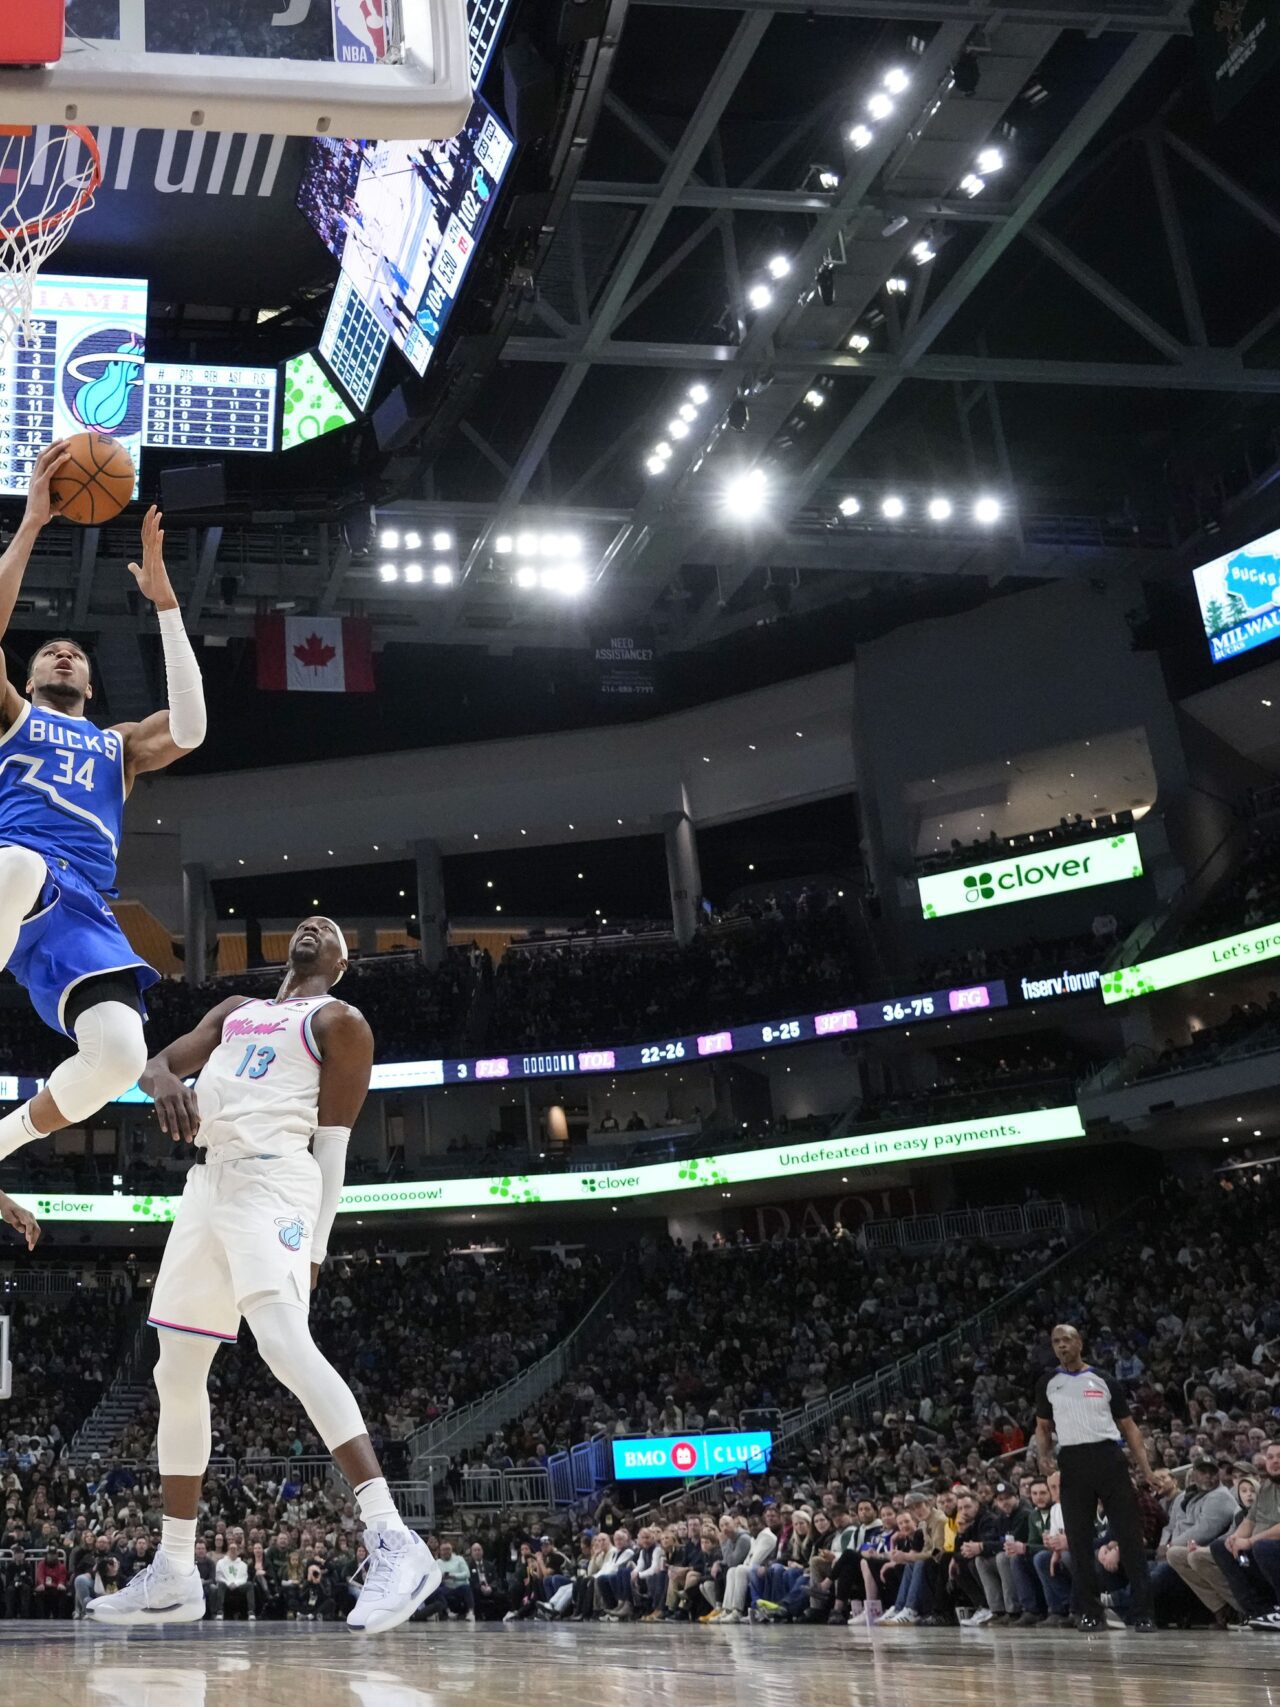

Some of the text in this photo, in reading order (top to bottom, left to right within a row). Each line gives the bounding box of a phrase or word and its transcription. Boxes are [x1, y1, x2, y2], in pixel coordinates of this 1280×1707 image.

[342, 45, 368, 62] NBA
[458, 190, 482, 230] 102
[439, 249, 459, 284] 5:50
[426, 280, 447, 318] 104
[30, 321, 46, 334] 22
[32, 353, 41, 365] 3
[31, 368, 41, 380] 8
[27, 383, 44, 396] 33
[155, 385, 262, 398] 13 22 7 1 4
[28, 399, 43, 412] 11
[155, 397, 261, 410] 14 33 11 1
[27, 415, 43, 427] 17
[206, 412, 213, 421] 2
[153, 422, 260, 435] 22 4 3 3
[26, 431, 42, 443] 12
[252, 439, 259, 447] 4
[1232, 567, 1276, 586] BUCKS
[611, 638, 634, 649] NEED
[595, 648, 653, 661] ASSISTANCE?
[29, 719, 118, 762] BUCKS
[53, 748, 96, 792] 34
[998, 856, 1091, 891] clover
[1212, 943, 1253, 964] Let's
[224, 1017, 289, 1043] Miami
[457, 989, 983, 1079] 3 FLS TOL 22-26 FT 8-25 3PT 36-75 FG
[235, 1043, 277, 1080] 13
[778, 1125, 1022, 1167] Undefeated in easy payments.
[598, 1176, 640, 1191] clover
[53, 1199, 94, 1213] clover
[624, 1444, 763, 1468] BMO CLUB
